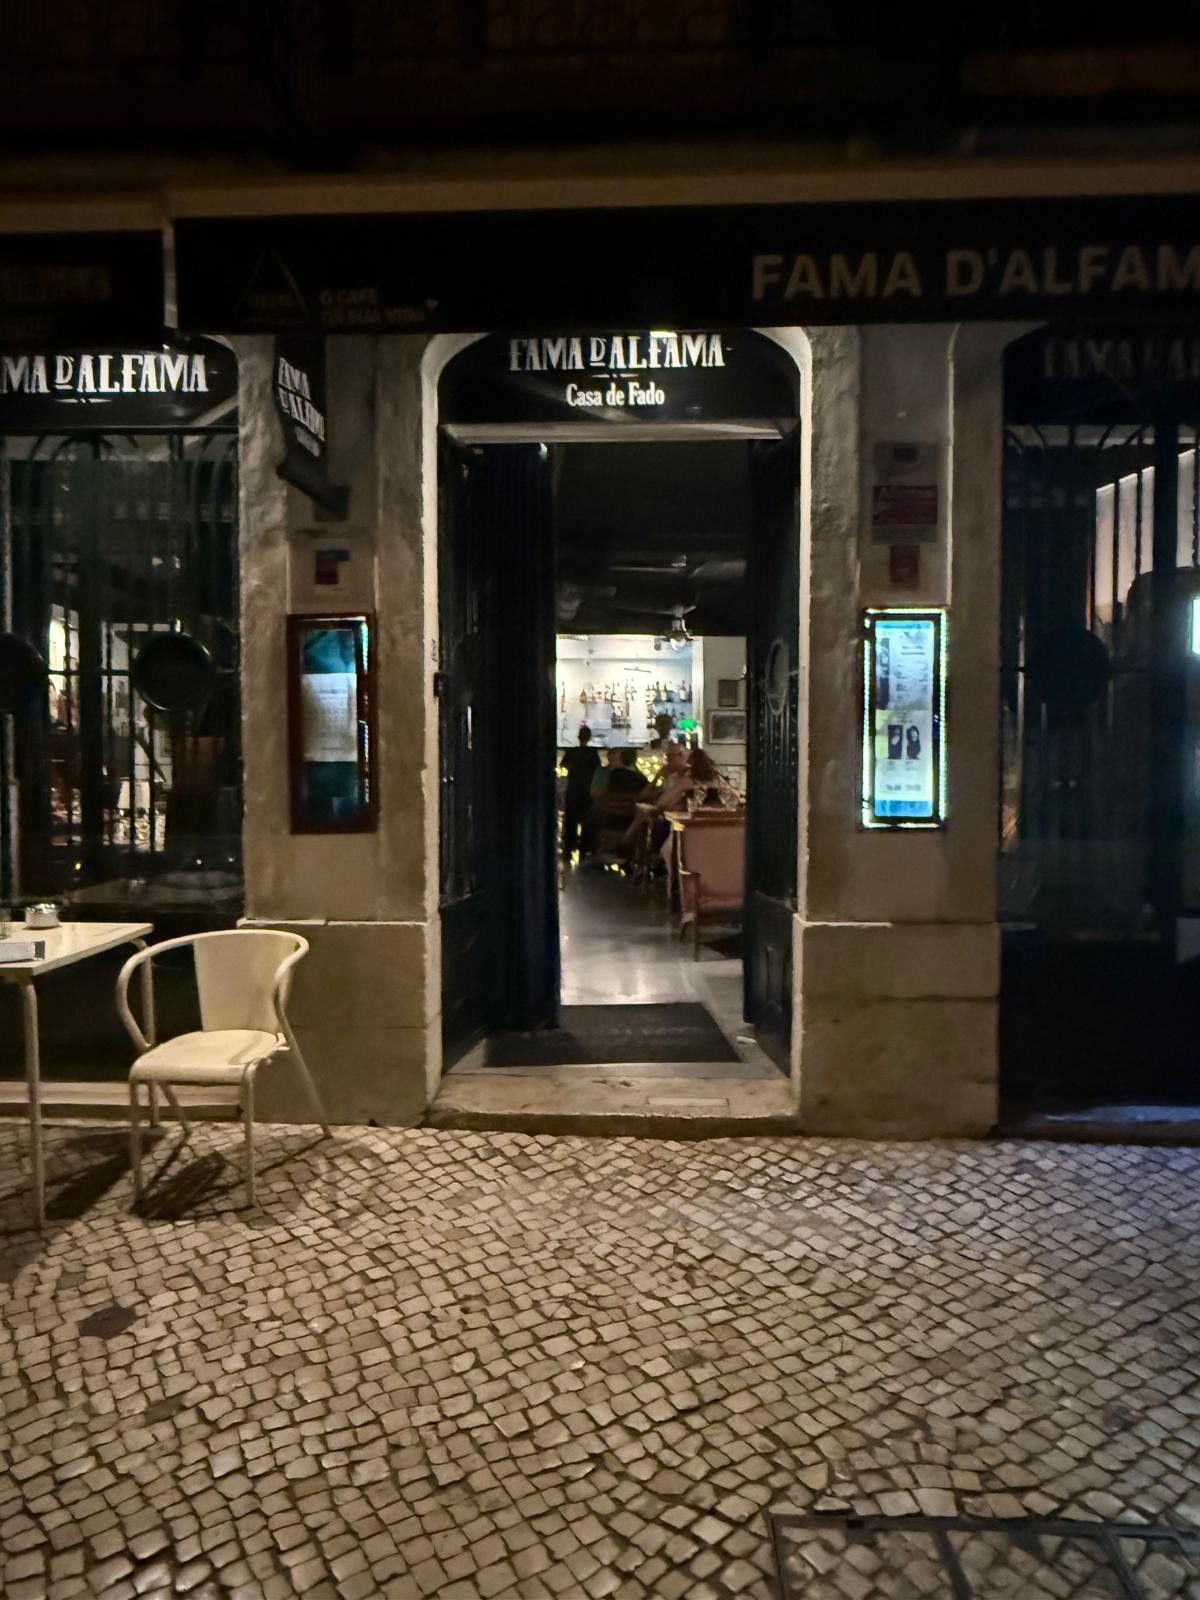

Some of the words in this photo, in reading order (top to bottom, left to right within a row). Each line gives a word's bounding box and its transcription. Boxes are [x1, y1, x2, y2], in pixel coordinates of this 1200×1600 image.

[752, 249, 924, 301] FAMA
[945, 243, 1200, 297] D'ALFAM
[509, 336, 586, 371] FAMA
[565, 382, 603, 408] Casa
[606, 381, 625, 406] de
[628, 380, 666, 406] Fado
